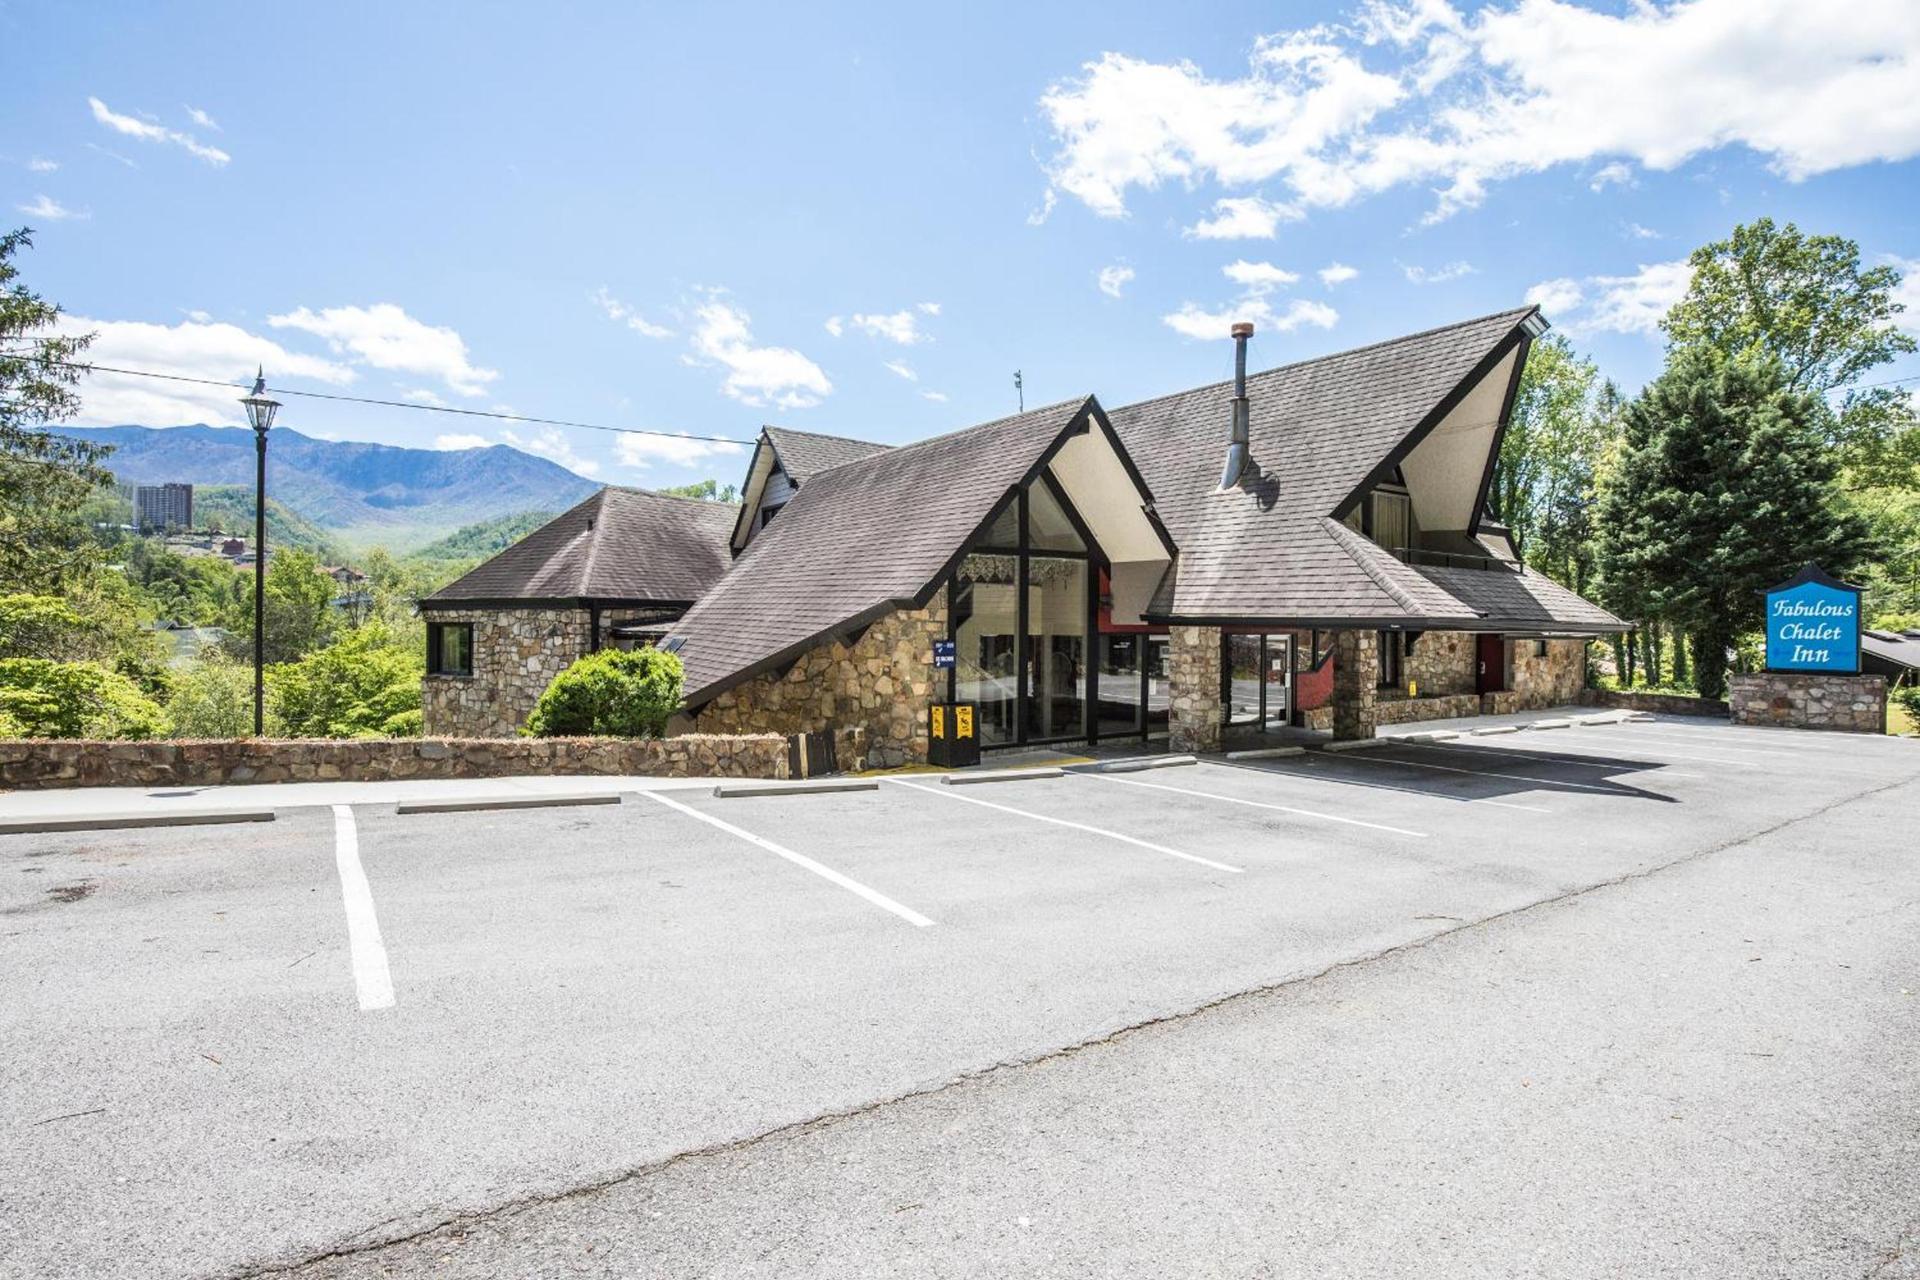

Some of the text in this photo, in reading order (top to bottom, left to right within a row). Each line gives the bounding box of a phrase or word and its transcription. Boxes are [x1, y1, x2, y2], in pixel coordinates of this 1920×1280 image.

[1772, 599, 1853, 616] Fabulous
[1780, 622, 1842, 640] Chalet
[1790, 645, 1830, 663] Inn
